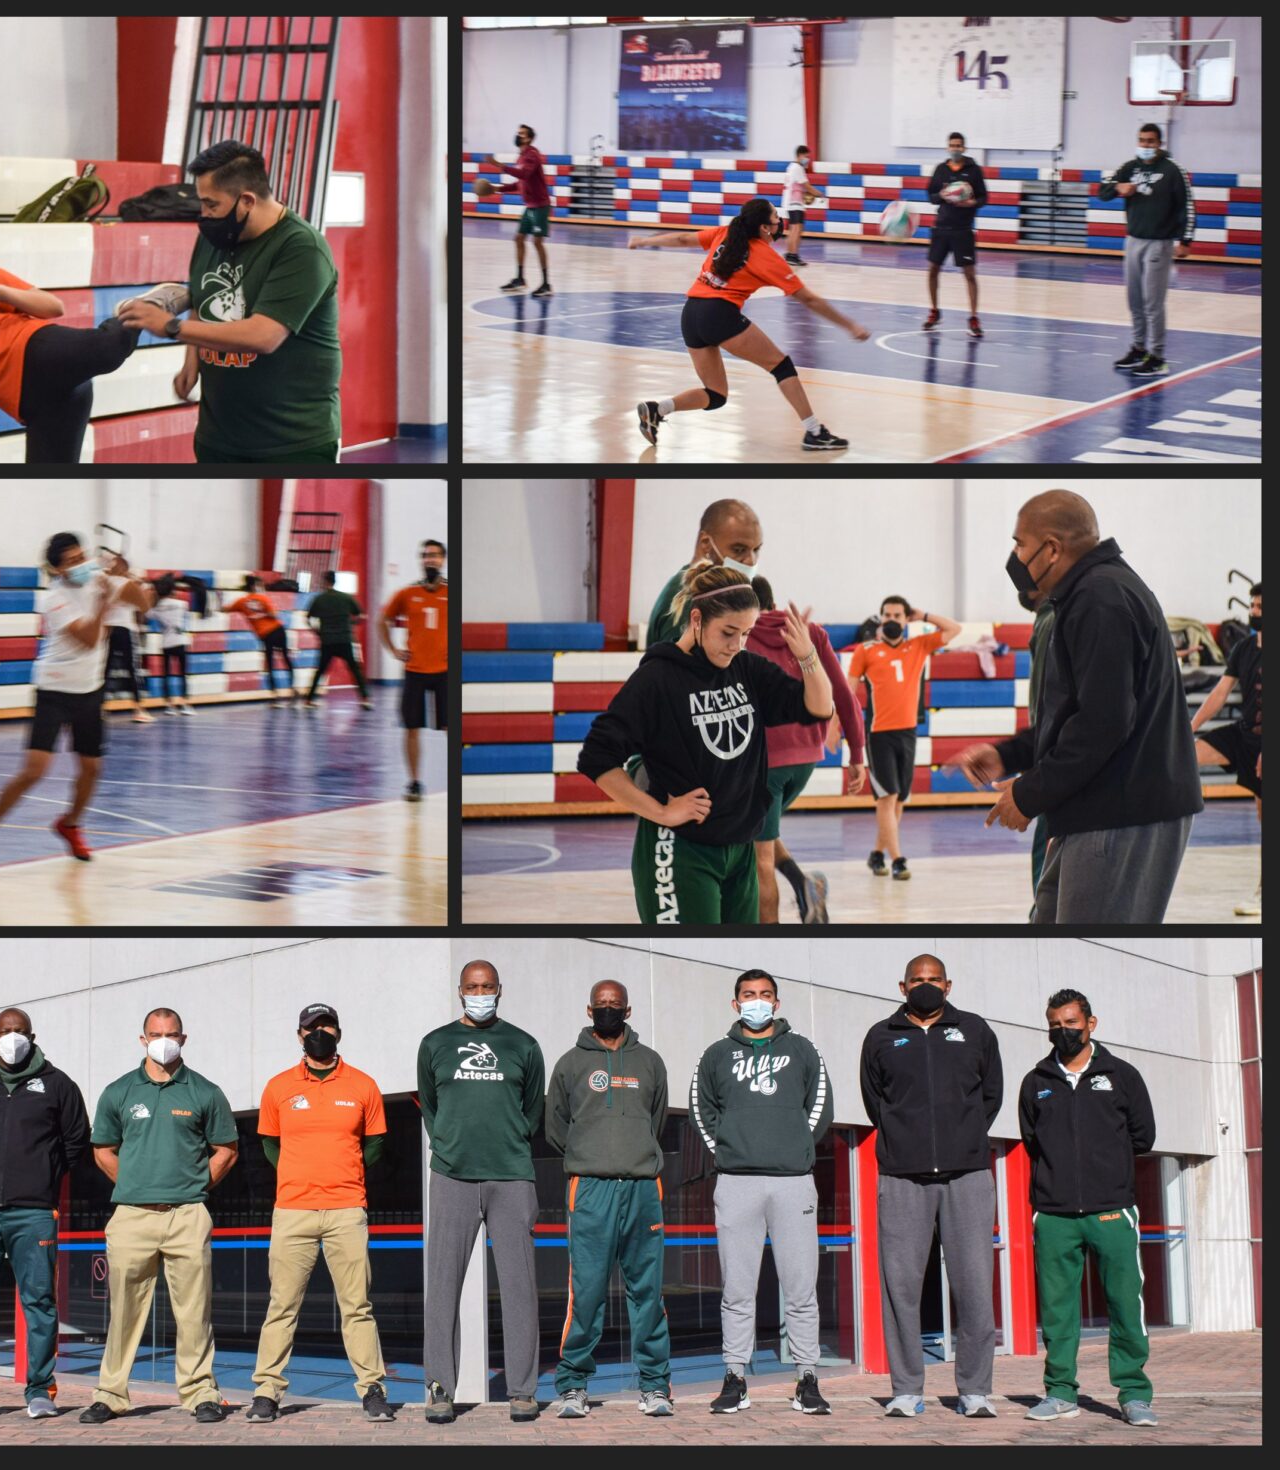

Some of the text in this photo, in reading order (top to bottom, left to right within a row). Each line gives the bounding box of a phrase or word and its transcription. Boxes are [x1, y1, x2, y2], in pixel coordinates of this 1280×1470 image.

[954, 50, 1009, 90] 145
[421, 606, 439, 630] 1
[890, 659, 904, 682] 1
[655, 826, 680, 925] Aztecas
[453, 1070, 504, 1081] Aztecas
[171, 1109, 192, 1117] UDLAP
